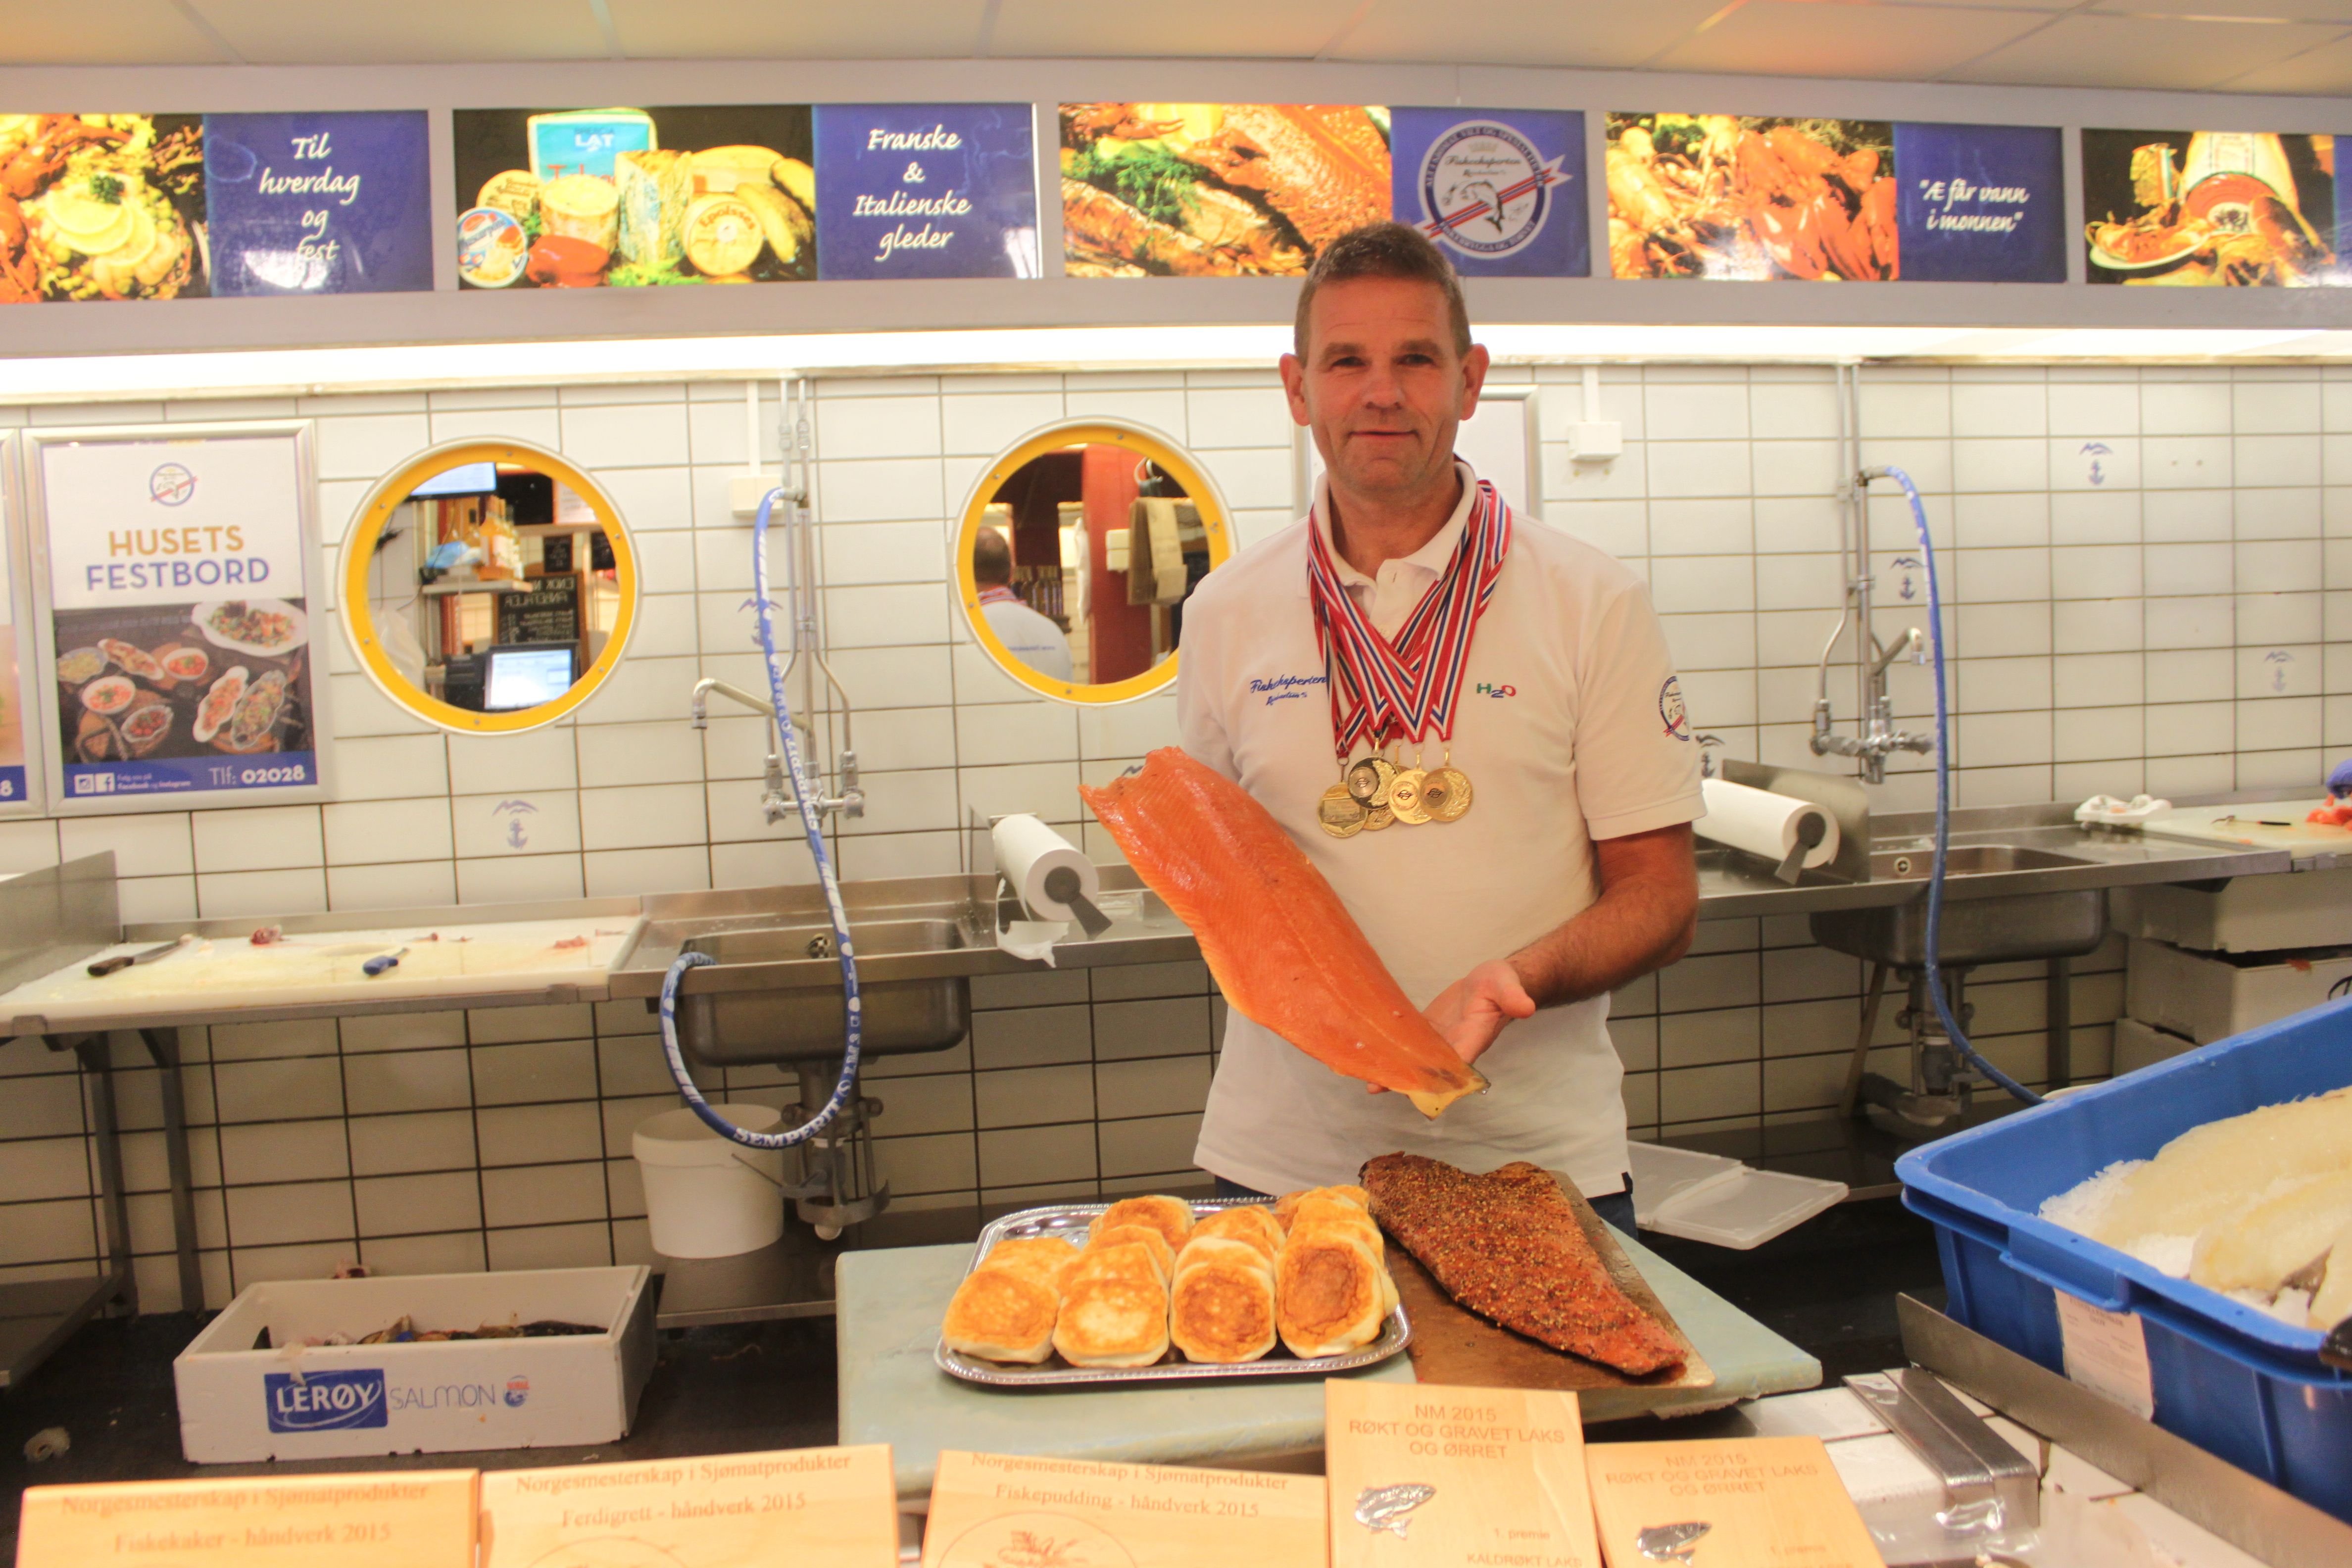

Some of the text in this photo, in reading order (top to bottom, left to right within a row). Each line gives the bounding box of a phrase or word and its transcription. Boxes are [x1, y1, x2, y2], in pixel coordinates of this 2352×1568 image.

[291, 132, 332, 159] Til
[867, 124, 963, 150] Franske
[259, 166, 360, 205] hverdag
[903, 161, 926, 184] &
[852, 189, 973, 216] Italienske
[1979, 187, 2030, 203] vann
[301, 210, 329, 241] og
[1926, 208, 1940, 230] i
[295, 235, 341, 267] fest
[874, 223, 954, 262] gleder
[109, 525, 244, 557] HUSETS
[86, 557, 270, 591] FESTBORD
[208, 764, 305, 785] Tlf: 02028
[734, 1097, 840, 1147] SEMPERIT
[276, 1382, 495, 1414] LERØY SALMON
[1415, 1405, 1497, 1422] NM 2015
[1349, 1420, 1565, 1444] RØKT OG GRAVET LAKS
[1409, 1441, 1508, 1459] OG ØRRET
[1666, 1454, 1747, 1468] NM 2015
[516, 1467, 683, 1496] Norgesmesterskap
[700, 1454, 850, 1483] Sjømatprodukter
[972, 1452, 1127, 1481] Norgesmesterskap
[1145, 1466, 1288, 1490] Sjømatprodukter
[1606, 1464, 1819, 1485] RØKT OG GRAVET LAKS
[61, 1489, 245, 1519] Norgesmesterskap
[265, 1482, 428, 1509] Sjømatprodukter
[995, 1484, 1112, 1510] Fiskepudding
[1130, 1495, 1210, 1514] håndverk
[1217, 1502, 1259, 1518] 2015
[1669, 1485, 1698, 1497] OG
[562, 1506, 652, 1528] Ferdigrett
[671, 1496, 755, 1519] håndverk
[761, 1492, 806, 1513] 2015
[245, 1524, 336, 1546] håndverk
[343, 1522, 391, 1543] 2015
